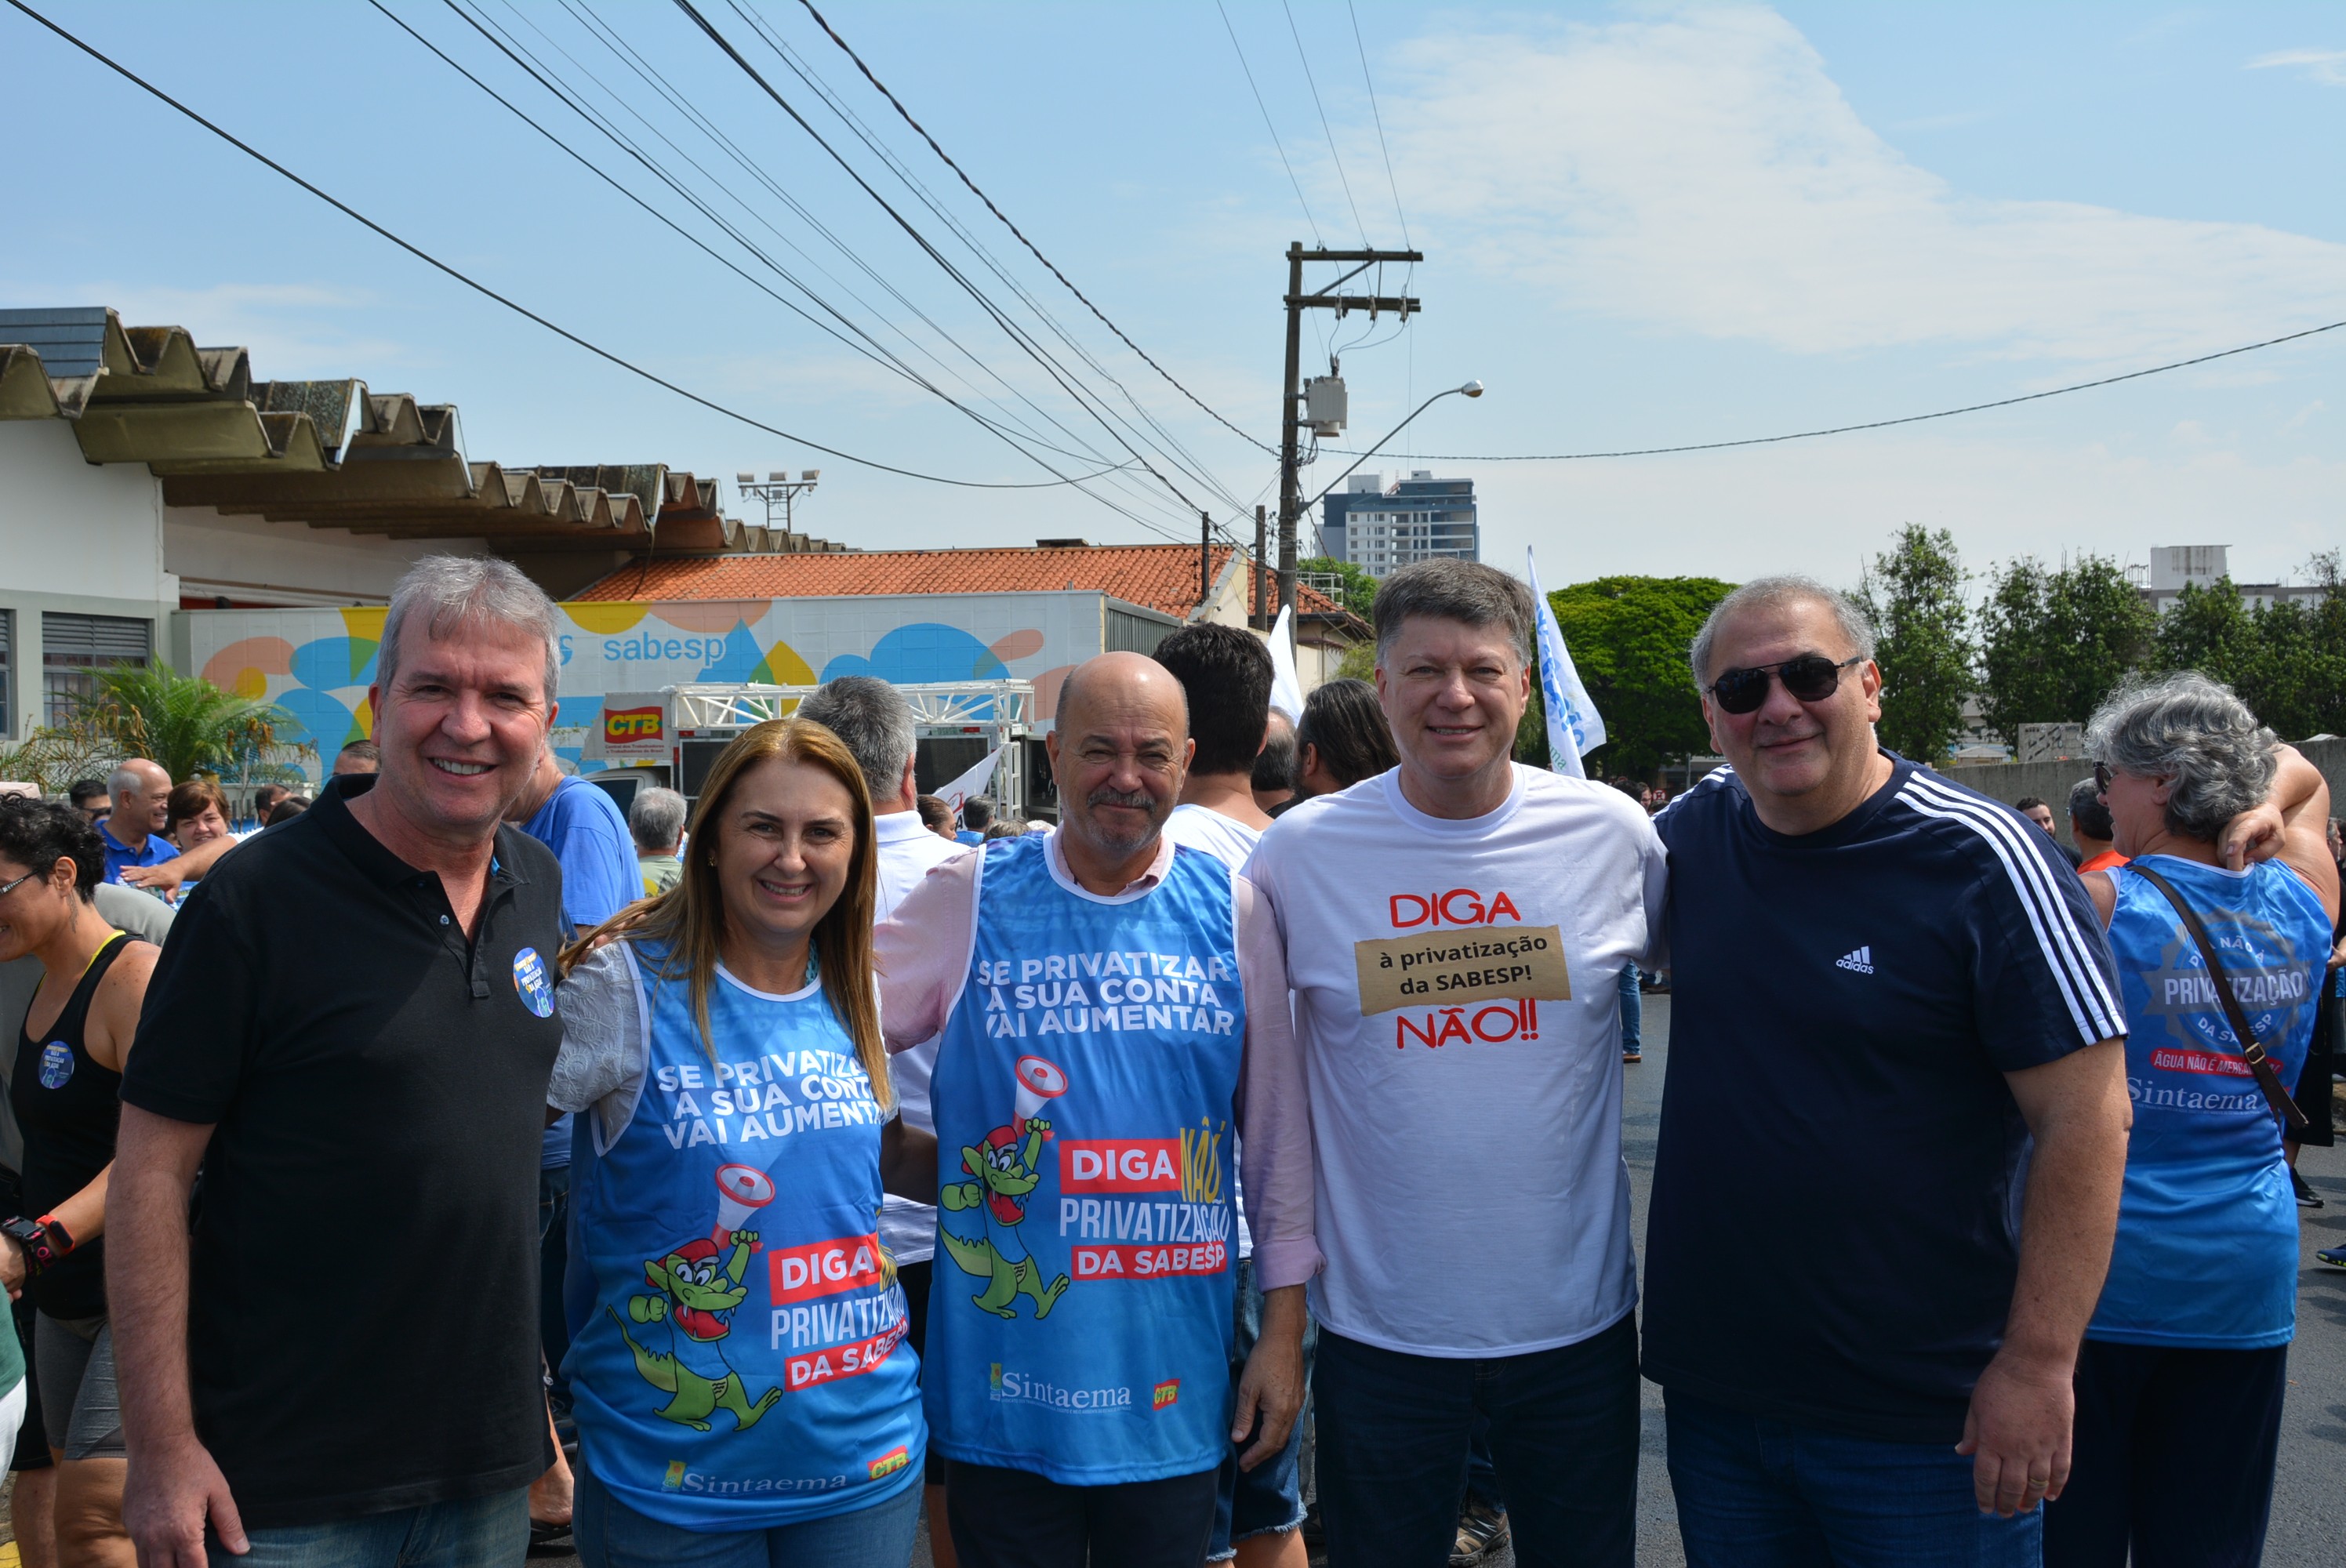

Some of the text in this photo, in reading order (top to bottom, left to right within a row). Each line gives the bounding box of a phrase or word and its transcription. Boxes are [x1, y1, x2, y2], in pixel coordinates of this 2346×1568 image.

[604, 631, 724, 666] sabesp
[608, 713, 659, 735] CTB
[1389, 888, 1521, 927] DIGA
[1380, 935, 1548, 971] à privatização
[2219, 935, 2253, 953] NÃO
[977, 951, 1232, 985] SE PRIVATIZAR
[1400, 964, 1532, 995] da SABESP!
[1836, 959, 1874, 975] adidas
[986, 978, 1222, 1011] A SUA CONTA
[2164, 969, 2304, 1006] PRIVAIZAÇÃO
[1037, 1005, 1234, 1036] AUMENTAR
[1396, 997, 1539, 1049] NÃO!!
[2197, 1014, 2272, 1043] DA SAESP
[657, 1048, 866, 1092] SE PRIVATIZA
[2186, 1054, 2206, 1071] NÃO
[673, 1074, 873, 1120] A SUA CONT
[2126, 1077, 2258, 1110] Sintaema
[662, 1118, 728, 1150] VAI
[1072, 1149, 1176, 1180] DIGA
[1059, 1198, 1230, 1247] PRIVATIZAÇÃO
[781, 1246, 875, 1290] DIGA
[1077, 1244, 1225, 1275] DA SABESP
[791, 1355, 833, 1386] DA
[1001, 1372, 1131, 1409] Sintaema
[1153, 1385, 1178, 1404] CTB
[681, 1451, 908, 1494] Sintaema CTB
